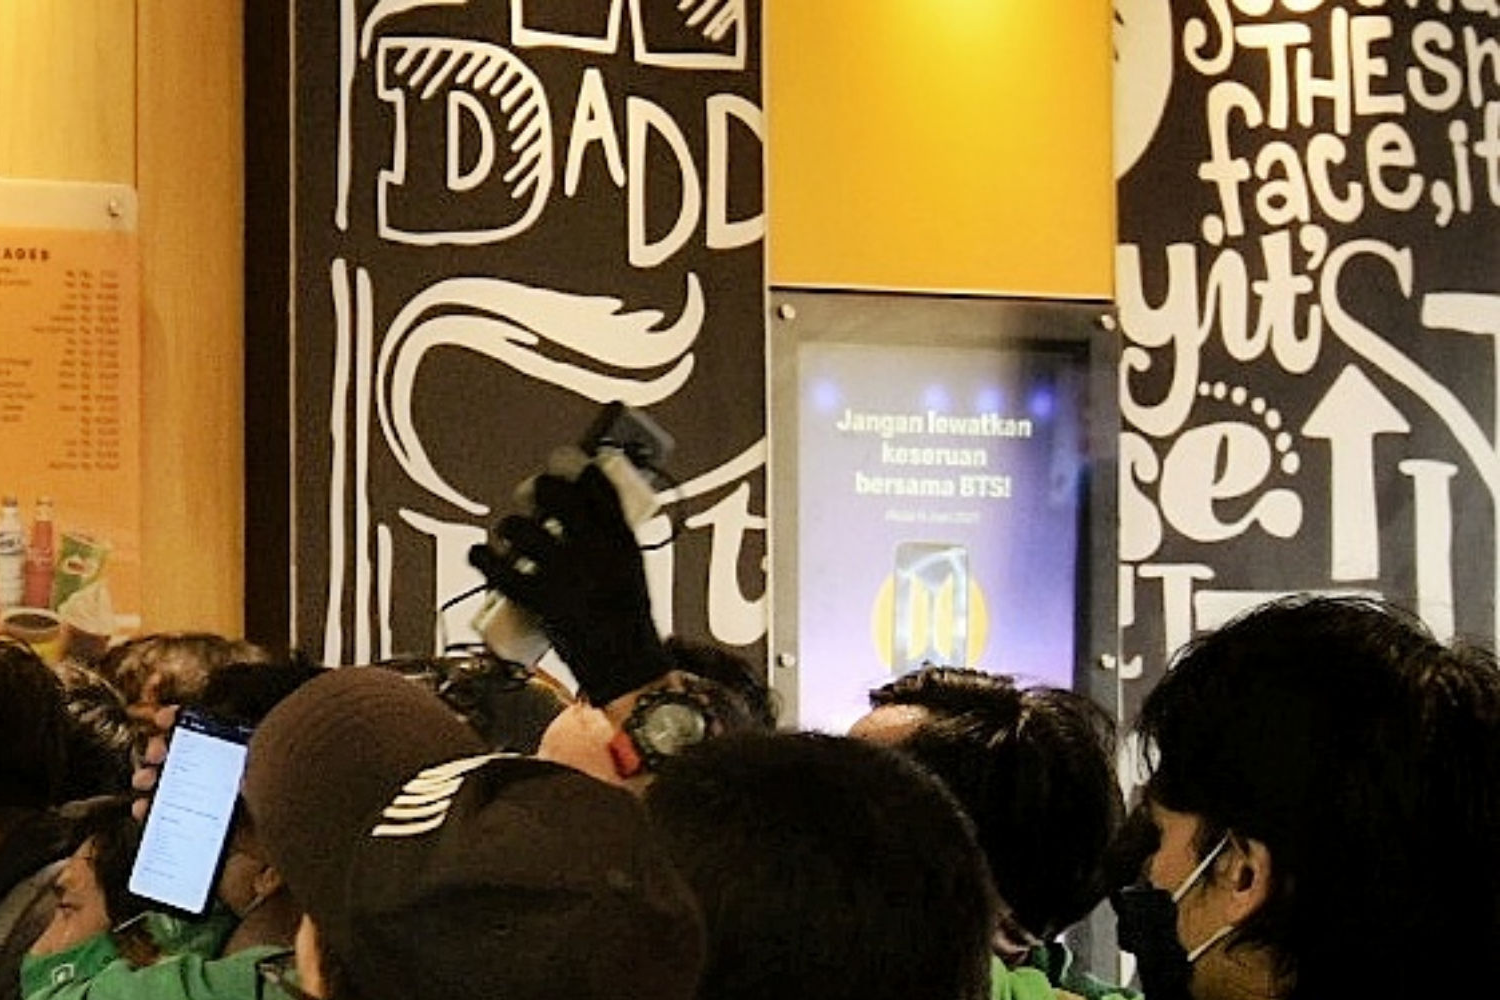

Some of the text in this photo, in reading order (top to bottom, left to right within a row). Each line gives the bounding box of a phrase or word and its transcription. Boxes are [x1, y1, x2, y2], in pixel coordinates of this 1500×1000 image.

[1235, 7, 1406, 135] THE
[836, 408, 1033, 438] Jangan lewatkan
[882, 441, 987, 466] keseruan
[855, 472, 1011, 498] bersama BTS!
